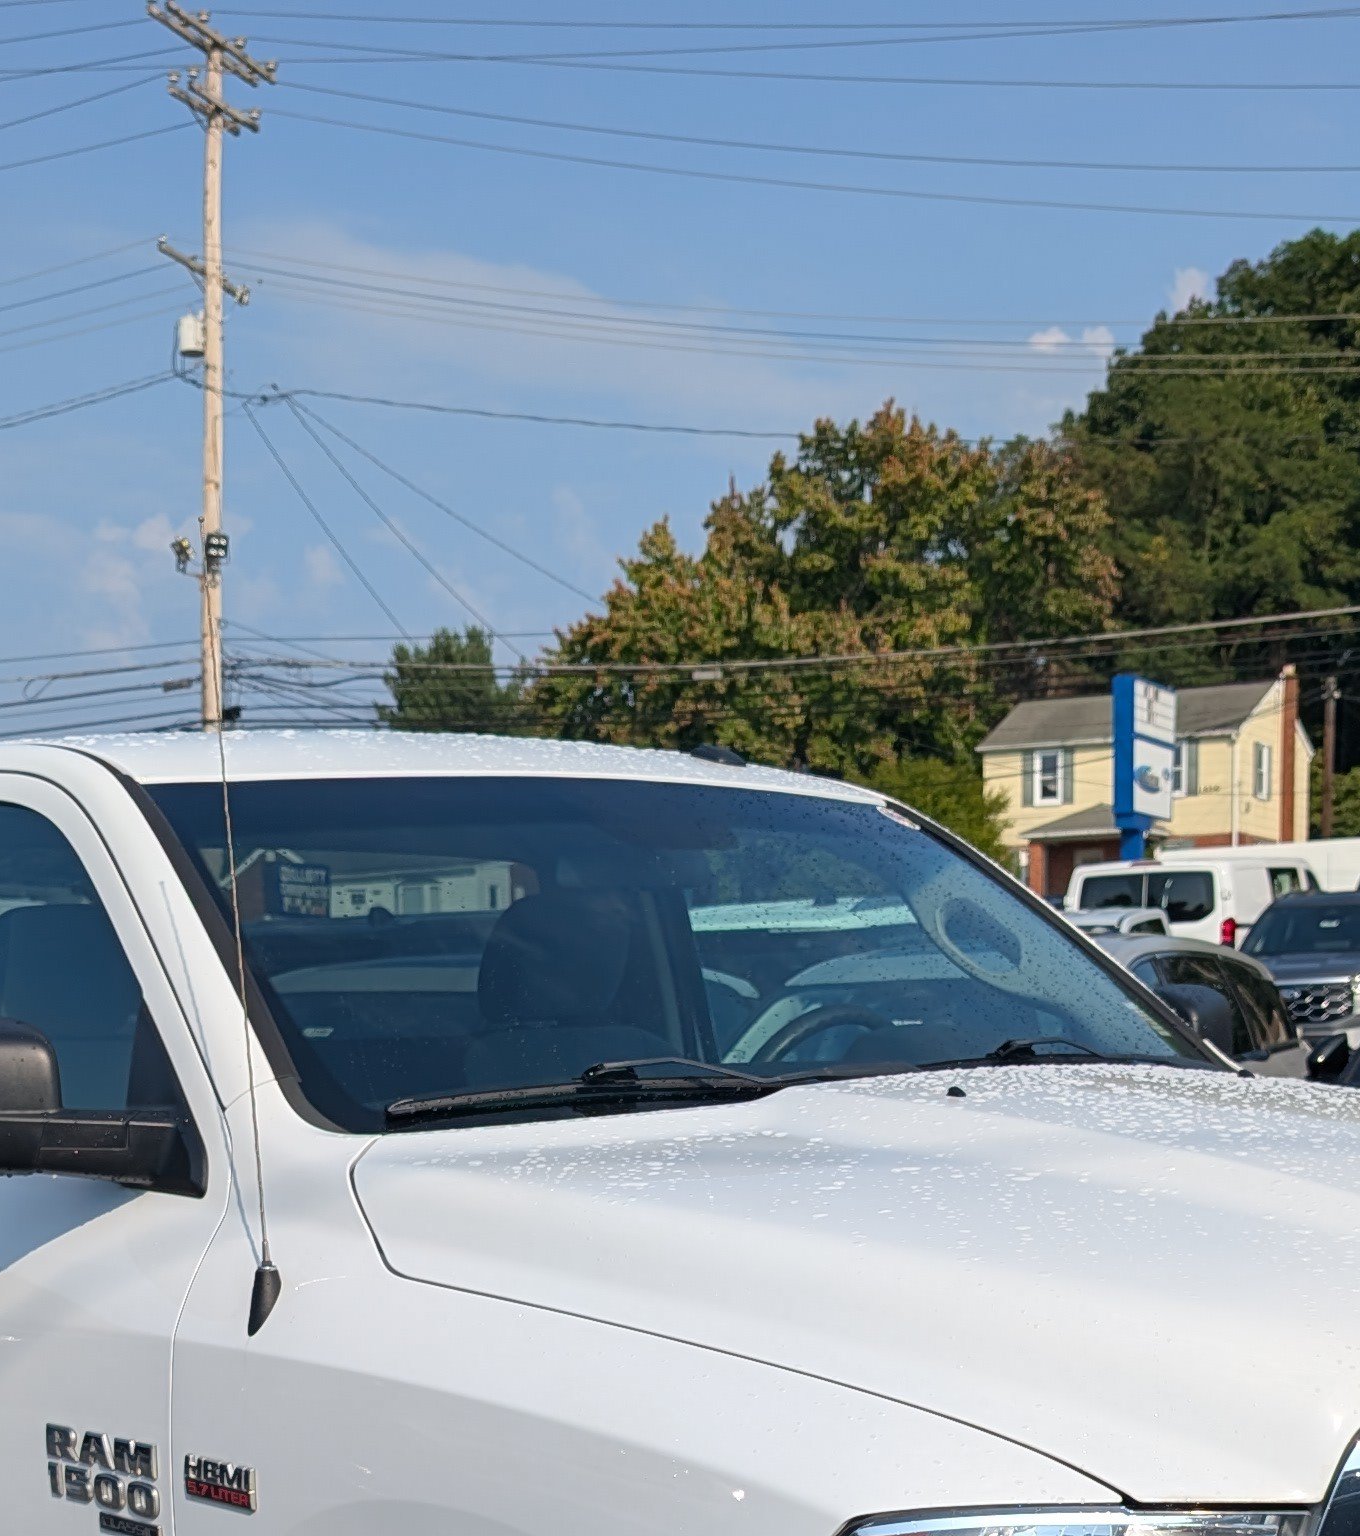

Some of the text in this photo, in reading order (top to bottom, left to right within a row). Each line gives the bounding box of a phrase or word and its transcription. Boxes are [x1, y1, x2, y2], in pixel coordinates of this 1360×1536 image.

[46, 1423, 159, 1481] RAM
[184, 1453, 257, 1493] HEMI
[48, 1461, 160, 1521] 1500
[186, 1479, 250, 1507] 5.7 LITER
